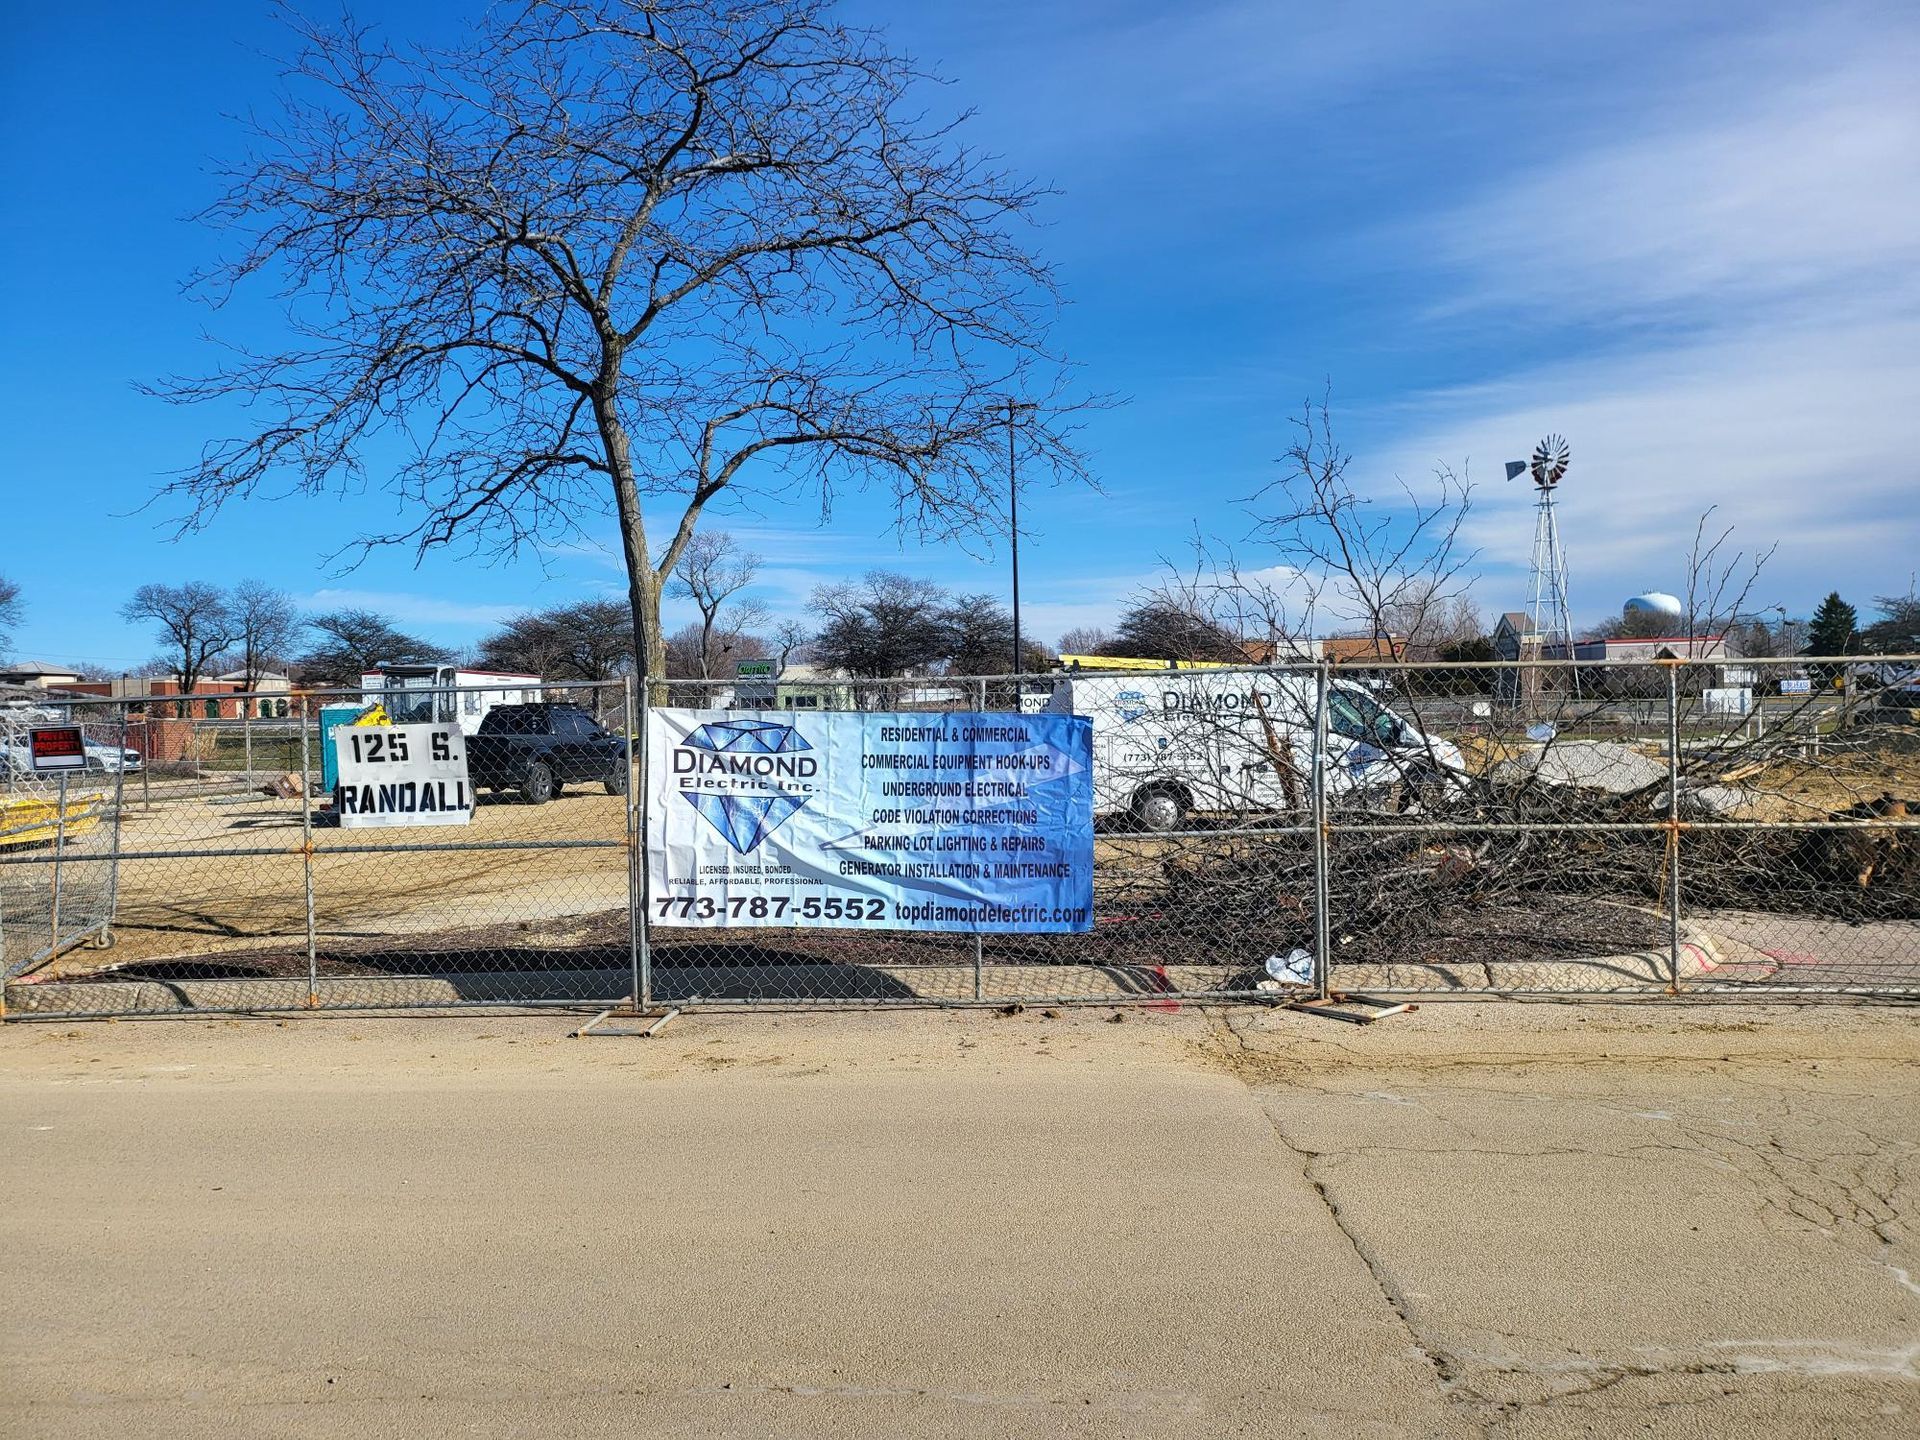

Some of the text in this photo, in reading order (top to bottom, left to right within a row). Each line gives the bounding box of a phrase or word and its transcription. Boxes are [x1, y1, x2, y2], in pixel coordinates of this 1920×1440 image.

[37, 731, 75, 741] PRIVATE
[881, 727, 1031, 743] RESIDENTIAL & COMMERCIAL
[34, 741, 80, 751] PROPERTY
[351, 731, 459, 763] 125 S.
[673, 749, 818, 778] DIAMOND
[861, 754, 1050, 770] COMMERCIAL EQUIPMENT HOOK-UPS
[679, 777, 820, 792] Electric Inc.
[882, 782, 1028, 797] UNDERGROUND ELECTRICAL
[339, 781, 470, 814] RANDALL
[873, 809, 1037, 825] CODE VIOLATION CORRECTIONS
[864, 835, 1045, 851] PARKING LOT LIGHTING & REPAIRS
[733, 865, 763, 875] INSURED,
[765, 865, 792, 874] BONDED
[839, 860, 1070, 879] GENERATOR INSTALLATION & MAINTENANCE
[669, 877, 824, 886] RELIABLE, AFFORDABLE, PROFESSIONAL
[656, 896, 1086, 925] 773-787-5552 topdiamondelectric.com
